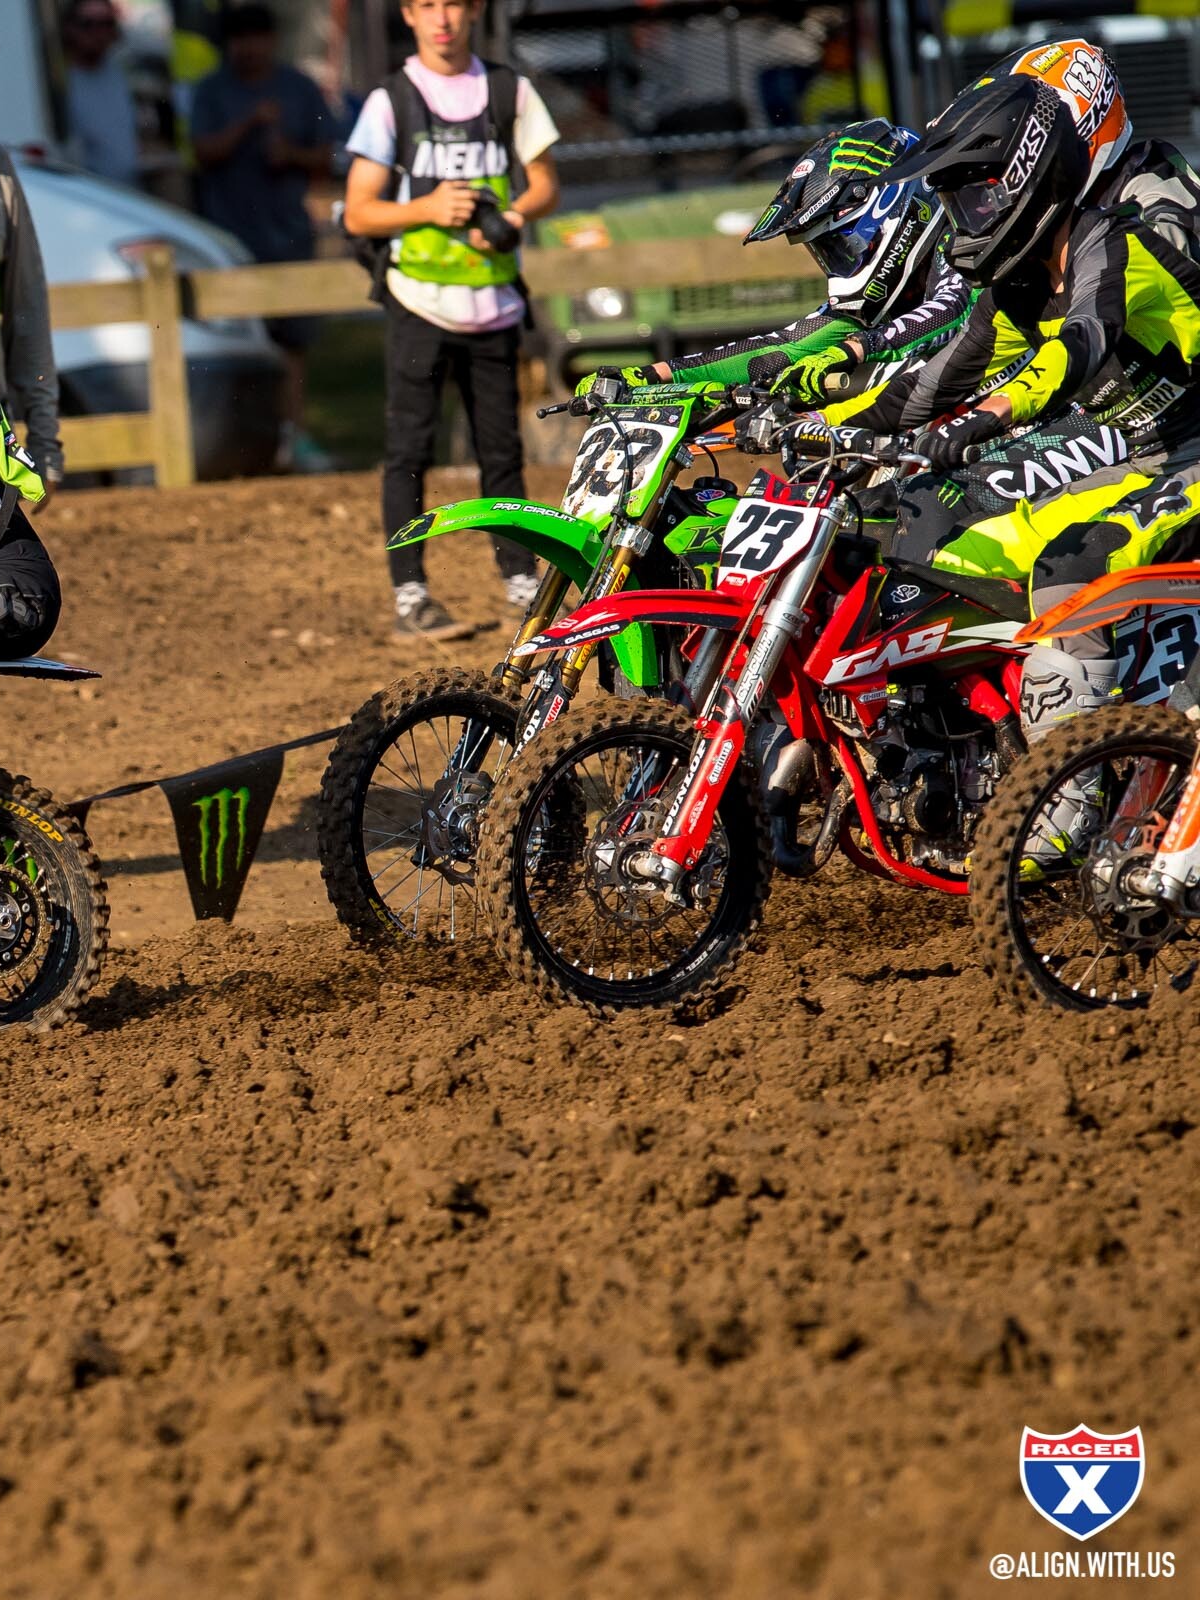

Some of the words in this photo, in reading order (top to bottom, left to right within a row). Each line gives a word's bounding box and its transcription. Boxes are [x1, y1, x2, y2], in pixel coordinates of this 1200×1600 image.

[1063, 49, 1103, 99] 132
[794, 163, 809, 176] BELL
[1002, 116, 1047, 194] EKS
[987, 426, 1127, 500] CANV
[493, 502, 522, 511] PRO
[523, 506, 577, 523] CIRCUIT
[722, 504, 804, 571] 23
[565, 624, 620, 644] GASGAS
[662, 738, 707, 835] DUNLOP
